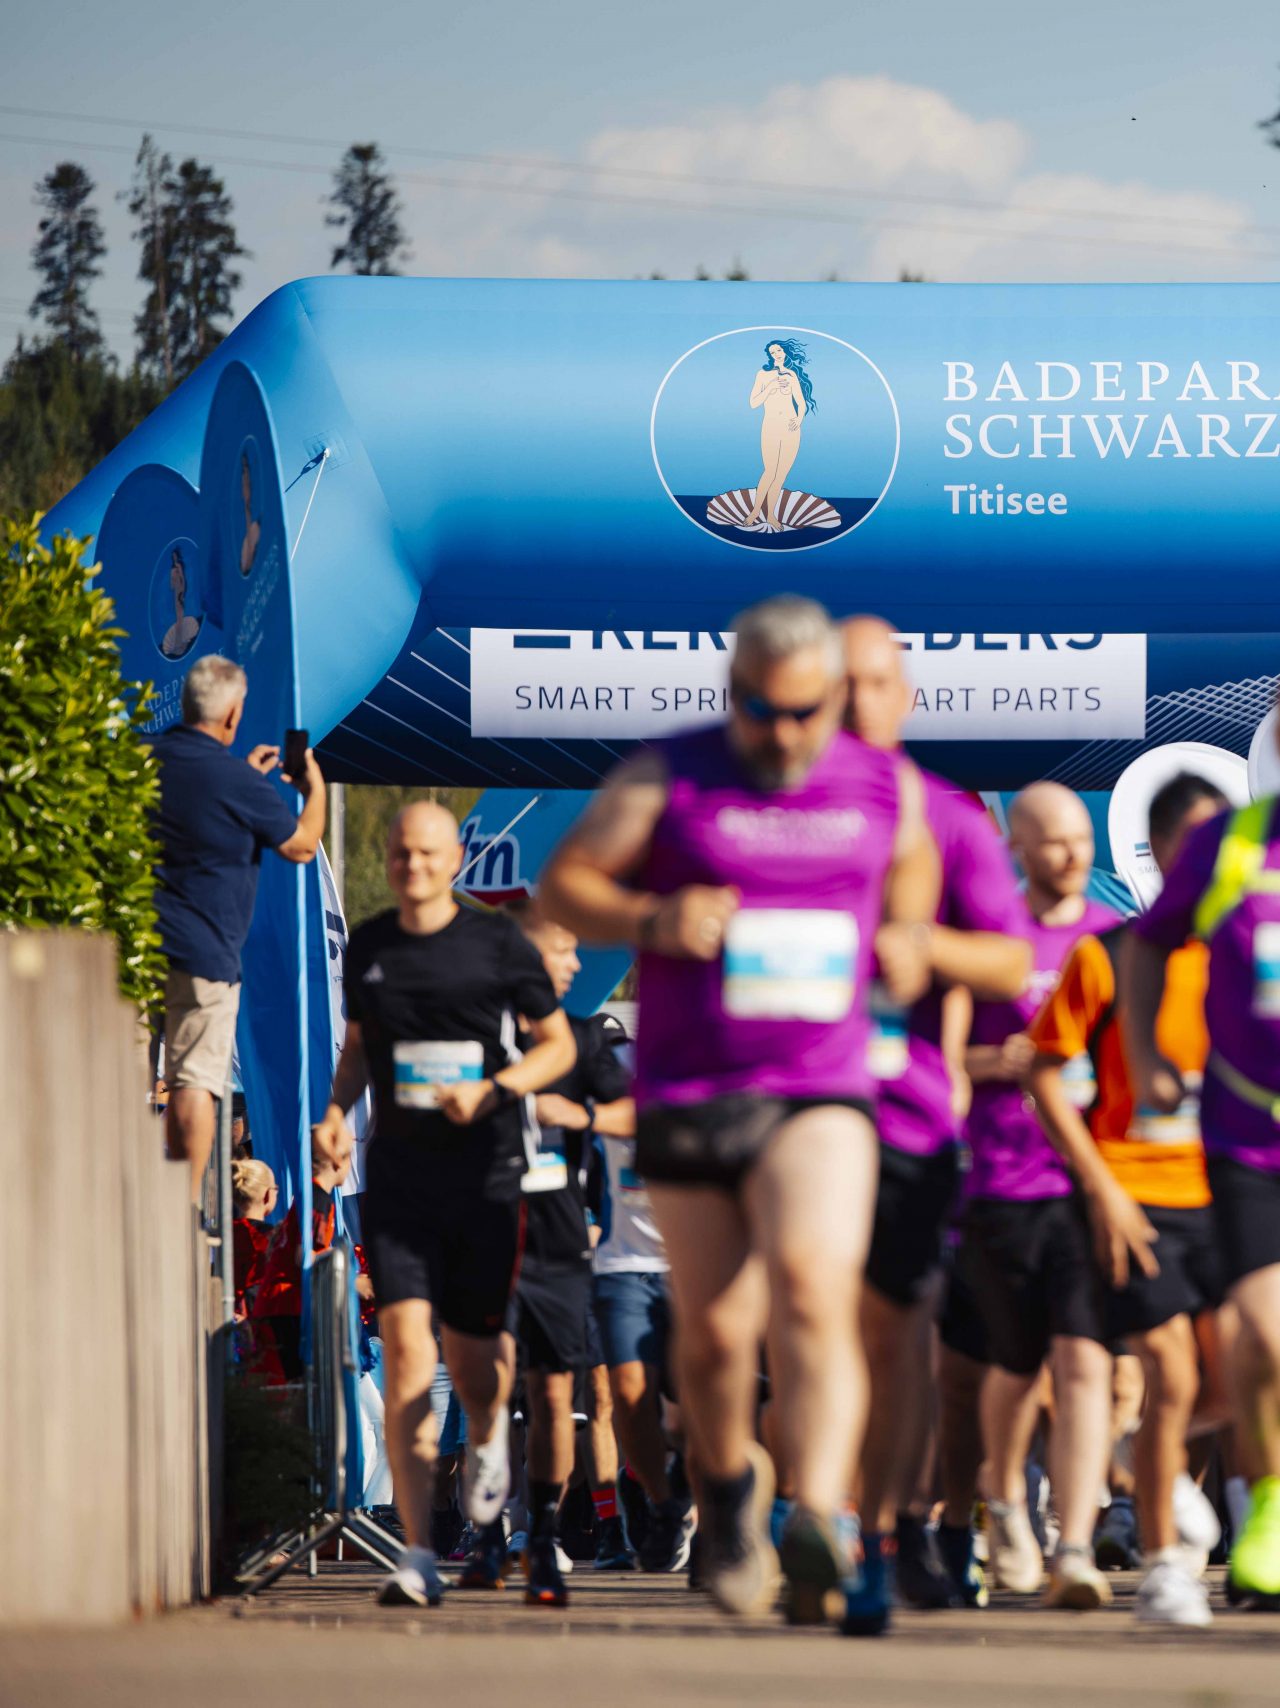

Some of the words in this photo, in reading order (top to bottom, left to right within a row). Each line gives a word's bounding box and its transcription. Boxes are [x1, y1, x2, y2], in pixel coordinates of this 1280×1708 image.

[943, 483, 1068, 515] Titisee
[515, 685, 636, 710] SMART
[651, 687, 728, 711] SPRI
[911, 687, 977, 712] ART
[993, 687, 1101, 712] PARTS
